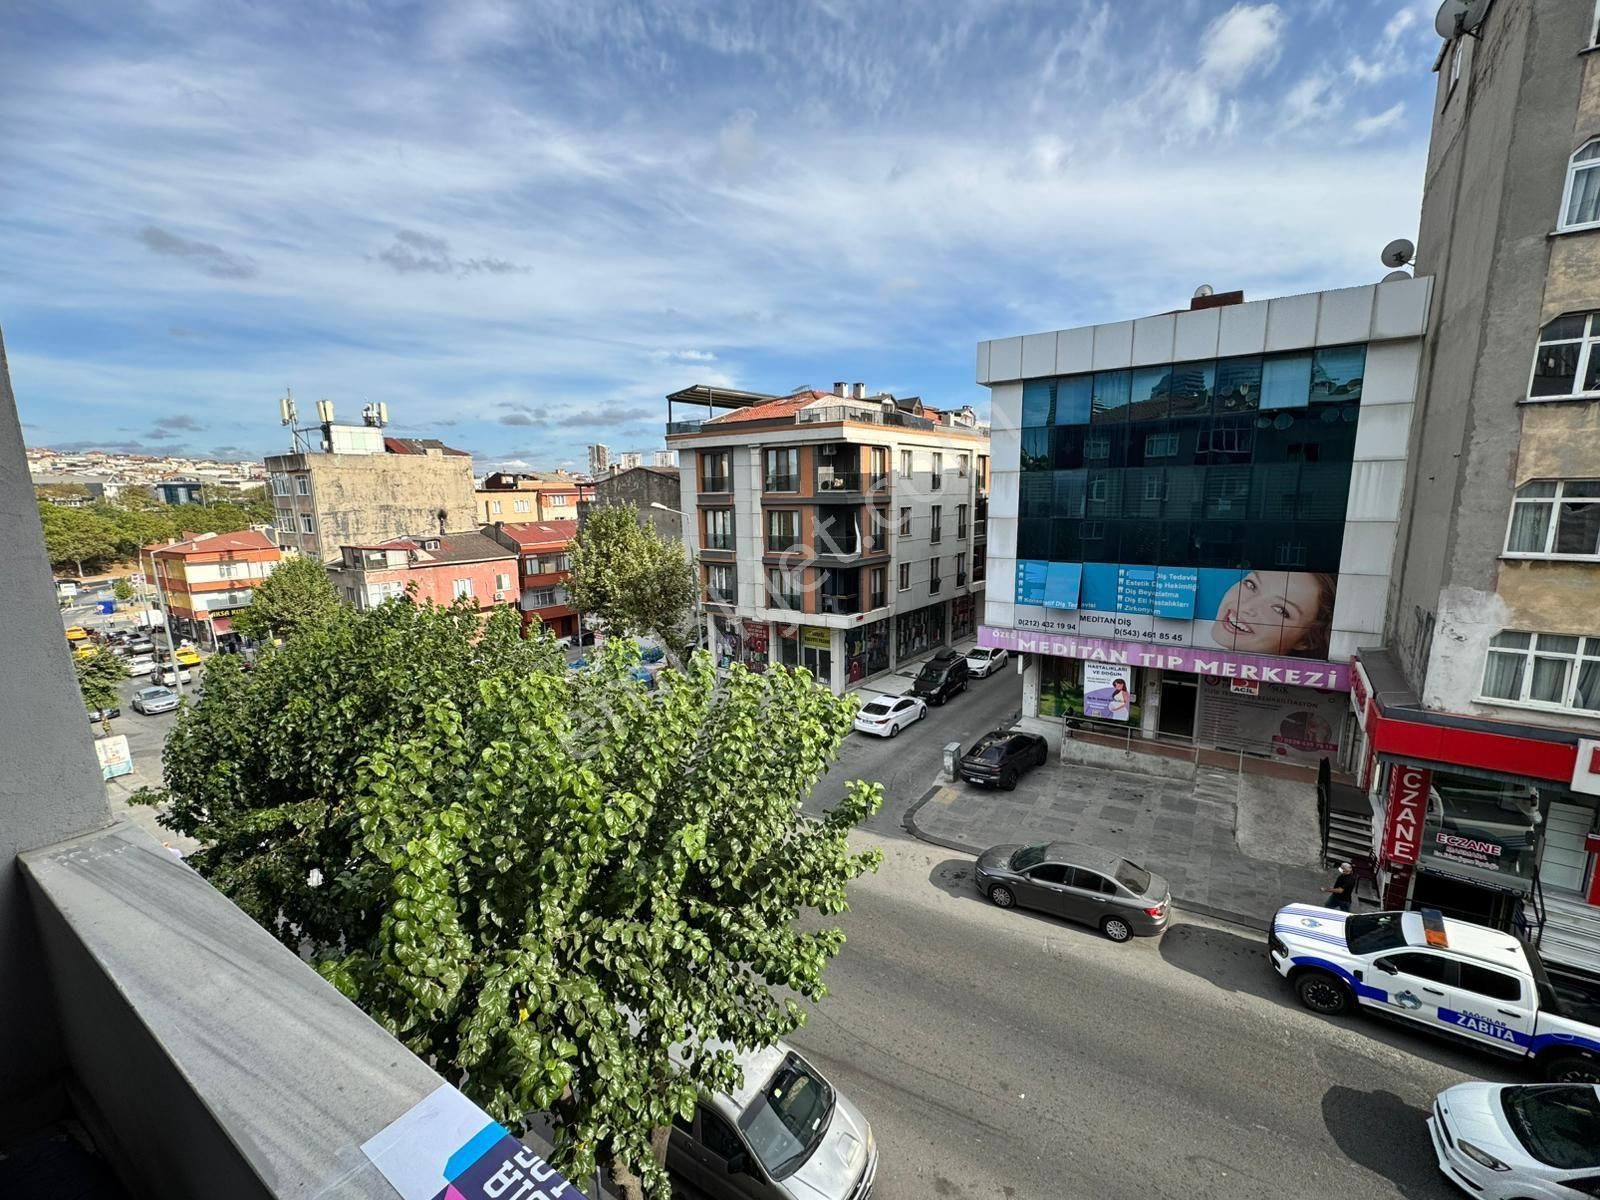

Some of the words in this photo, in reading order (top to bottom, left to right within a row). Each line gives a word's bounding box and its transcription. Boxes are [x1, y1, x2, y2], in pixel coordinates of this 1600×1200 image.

[1018, 619, 1040, 628] 0(212)
[1080, 615, 1116, 624] MEDİTAN
[1118, 617, 1132, 626] DİŞ
[1114, 628, 1140, 638] 0(543)
[1018, 638, 1128, 664] MEDİTAN
[1138, 652, 1183, 670] TIP
[1194, 658, 1337, 688] MERKEZİ
[1088, 664, 1128, 672] HASTALIKLARI
[1394, 766, 1422, 860] CZANE
[1436, 832, 1502, 856] ECZANE
[1457, 1014, 1515, 1042] ZABITA
